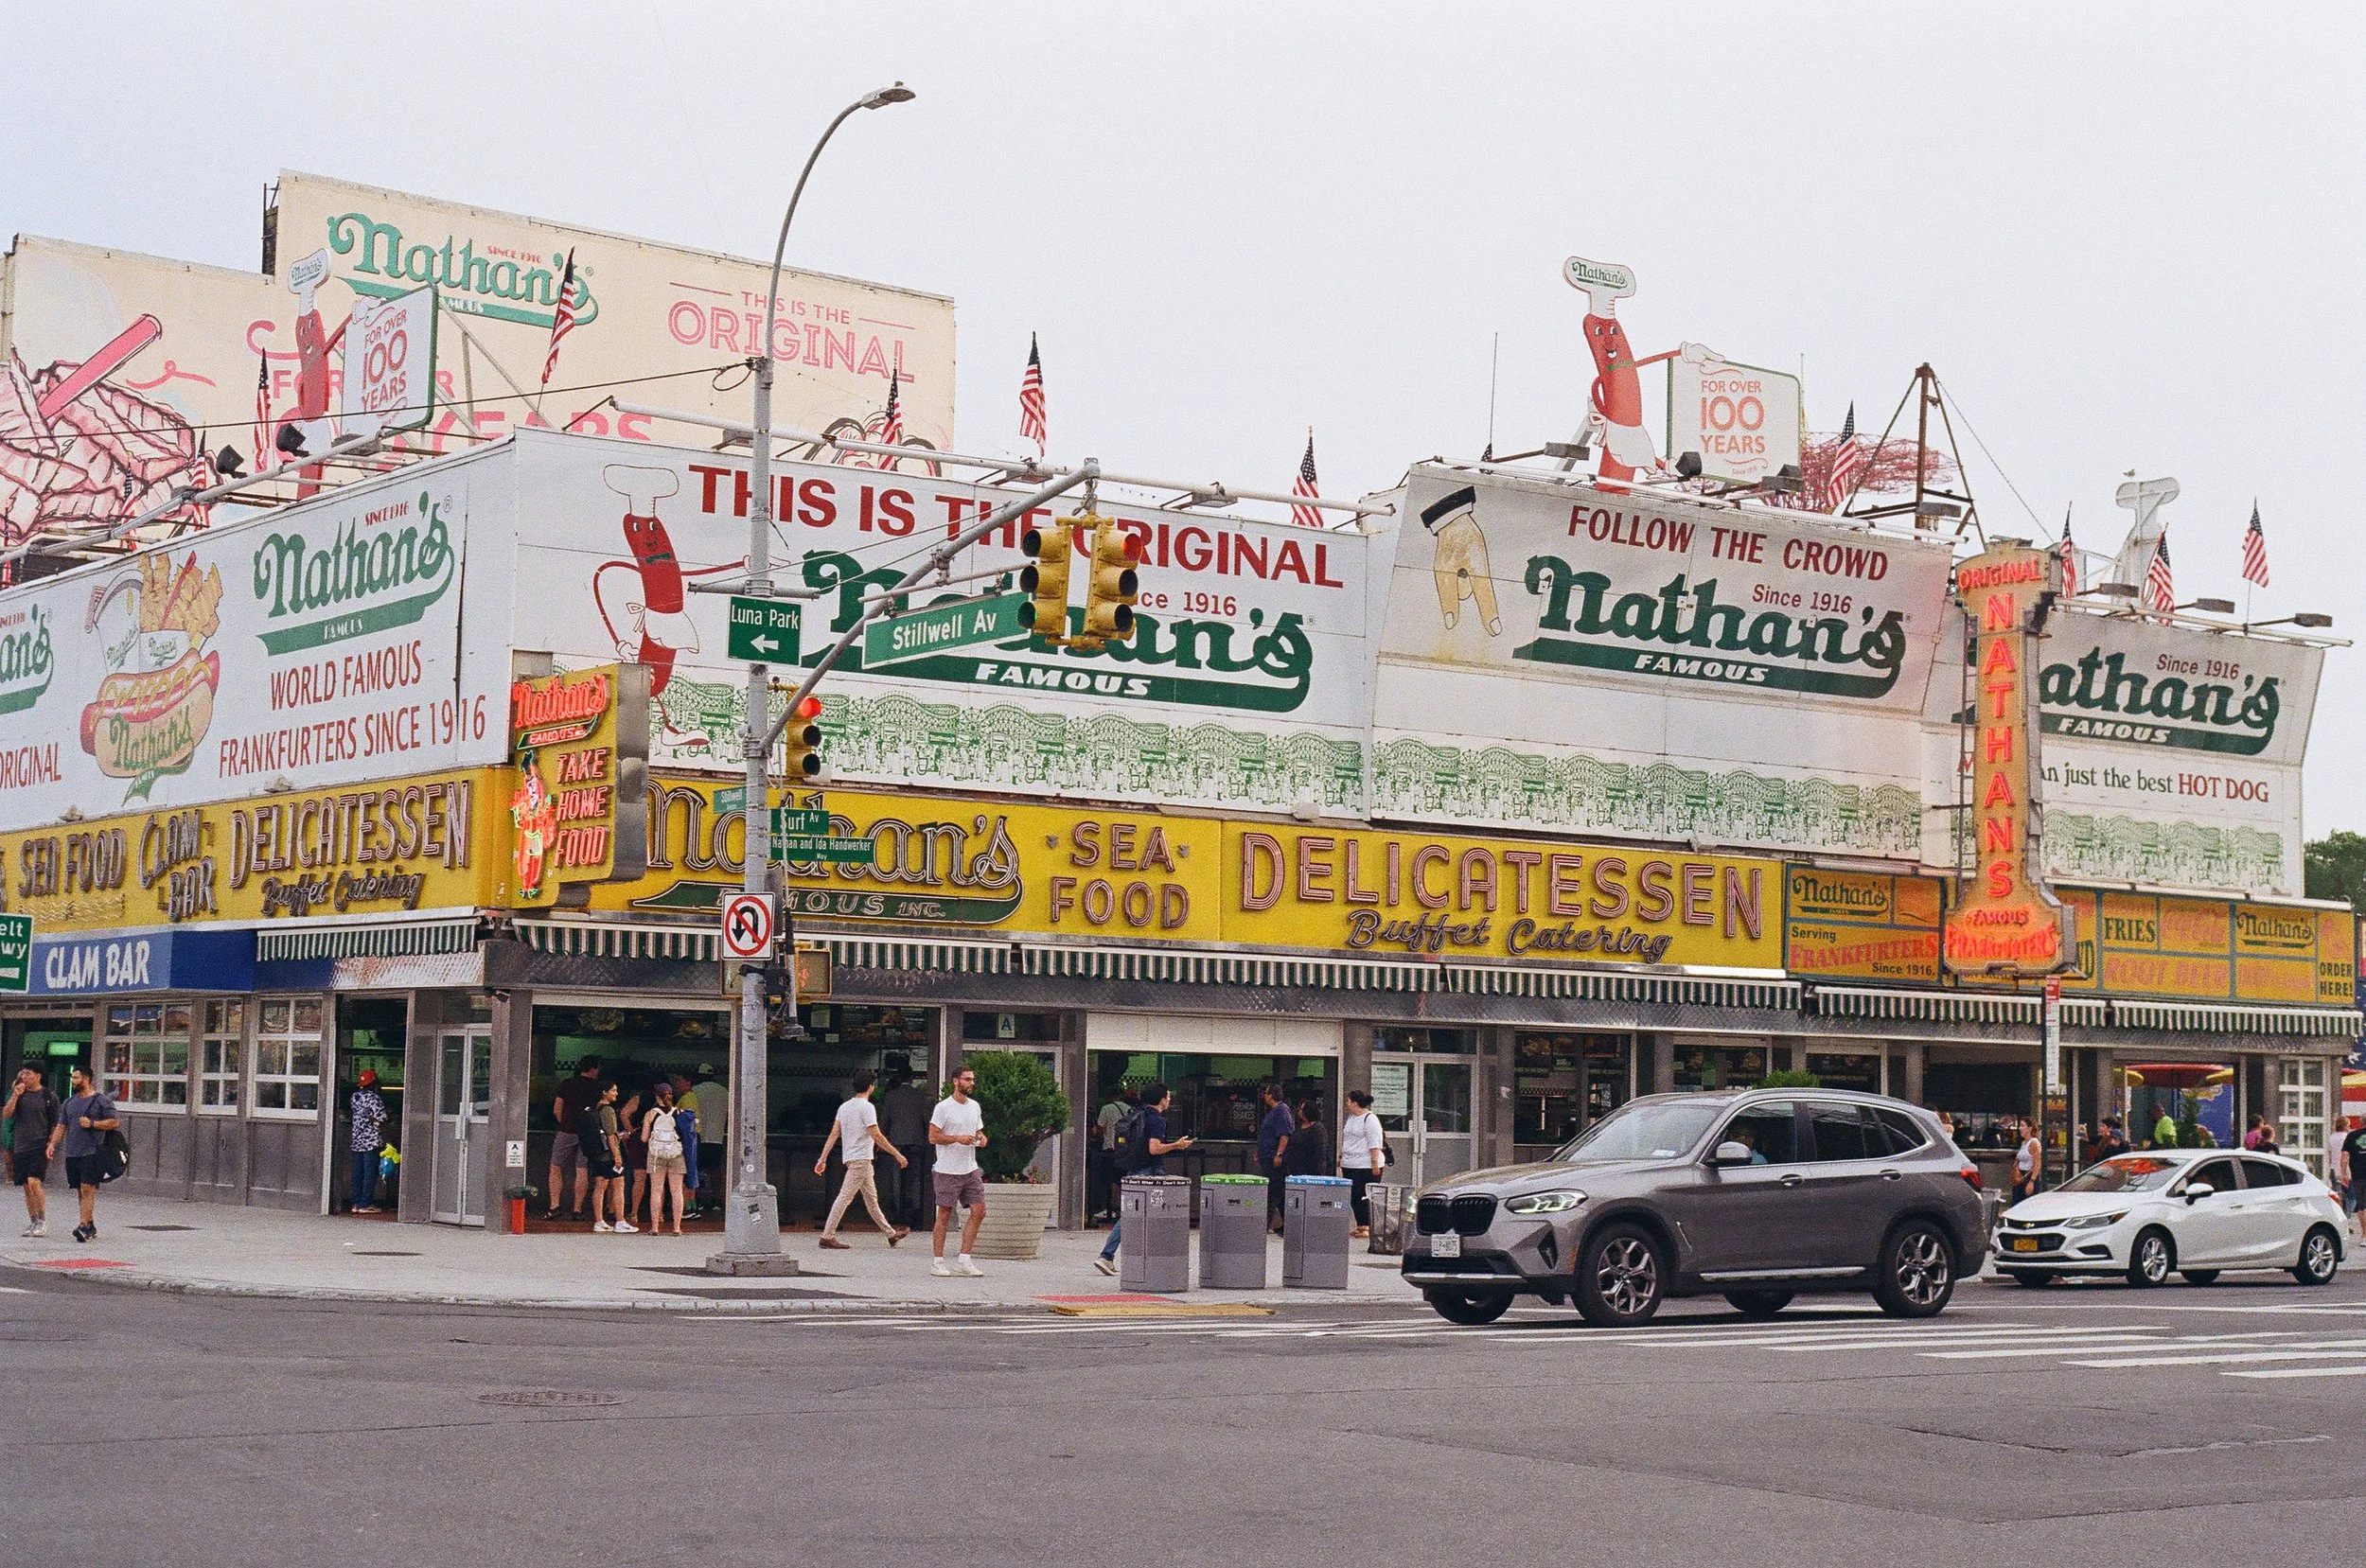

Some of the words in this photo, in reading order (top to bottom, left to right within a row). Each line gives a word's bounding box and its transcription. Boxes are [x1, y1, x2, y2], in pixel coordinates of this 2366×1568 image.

[327, 212, 591, 310] Nathan's
[1571, 261, 1627, 285] Nathan's
[364, 326, 381, 350] FOR
[383, 308, 407, 334] OVER
[741, 291, 785, 312] THS
[791, 300, 805, 317] IS
[812, 304, 851, 325] THE
[362, 328, 408, 391] 100
[667, 300, 915, 384] ORIGINAL
[361, 370, 407, 414] YEARS
[1701, 379, 1725, 393] FOR
[1729, 380, 1761, 393] OVER
[1699, 395, 1765, 432] 100
[1699, 434, 1766, 455] YEARS
[365, 507, 388, 527] SINCE
[689, 464, 837, 529] THIS
[859, 485, 916, 537] IS
[253, 490, 450, 619] Nathan's
[1568, 505, 1697, 555] FOLLOW
[1710, 526, 1768, 565] THE
[1783, 537, 1890, 581] CROWD
[1956, 556, 2043, 590] ORIGINAL
[731, 603, 763, 625] Luna
[768, 607, 800, 630] Park
[1183, 590, 1237, 617] 1916
[1525, 554, 1906, 670] Nathan's
[1752, 583, 1803, 610] Since
[1809, 590, 1852, 614] 1916
[892, 613, 962, 650] Stillwell
[973, 608, 998, 635] Av
[271, 660, 337, 711] WORLD
[343, 639, 422, 698] FAMOUS
[975, 662, 1153, 696] FAMOUS
[1633, 653, 1771, 683] FAMOUS
[2039, 645, 2281, 730] athan's
[2156, 653, 2198, 675] Since
[2204, 661, 2240, 680] 1916
[513, 673, 609, 729] Nathan's
[219, 716, 358, 779] FRANKFURTERS
[363, 705, 421, 757] SINCE
[429, 694, 486, 746] 1916
[529, 728, 574, 745] FAMOUS
[1984, 592, 2015, 898] NATHANS
[2057, 717, 2171, 744] FAMOUS
[556, 749, 609, 784] TAKE
[2063, 761, 2098, 787] just
[2104, 766, 2131, 789] the
[2137, 768, 2174, 794] best
[2178, 773, 2222, 798] HOT
[2226, 779, 2269, 803] DOG
[556, 787, 609, 821] HOME
[781, 812, 805, 831] Surf
[809, 811, 820, 823] Av
[137, 808, 201, 890] CLAM
[229, 780, 472, 890] DELICATESSEN
[554, 825, 608, 868] FOOD
[647, 779, 1019, 890] Nahan's
[772, 835, 798, 850] Nahan
[800, 837, 813, 850] and
[815, 837, 827, 851] Ida
[829, 838, 871, 852] Handwerker
[1070, 820, 1175, 872] SEA
[18, 836, 61, 898] SEA
[64, 828, 127, 894] FOOD
[168, 855, 220, 923] BAR
[260, 871, 330, 916] Buffet
[334, 864, 424, 911] Catering
[1049, 875, 1191, 929] FOOD
[1241, 831, 1763, 941] DELICATESSEN
[1792, 873, 1890, 908] Nathan's
[1347, 908, 1492, 952] Buffet
[1507, 916, 1674, 964] Catering
[1791, 926, 1837, 943] Serving
[2104, 917, 2156, 943] FRIES
[2236, 911, 2314, 940] Nathan's
[44, 943, 100, 989] CLAM
[105, 940, 150, 986] BAR
[1872, 961, 1903, 975] Since
[1906, 964, 1935, 977] 1916.
[2319, 961, 2353, 978] ORDER
[2319, 981, 2353, 997] HERE!
[1000, 1016, 1013, 1031] A
